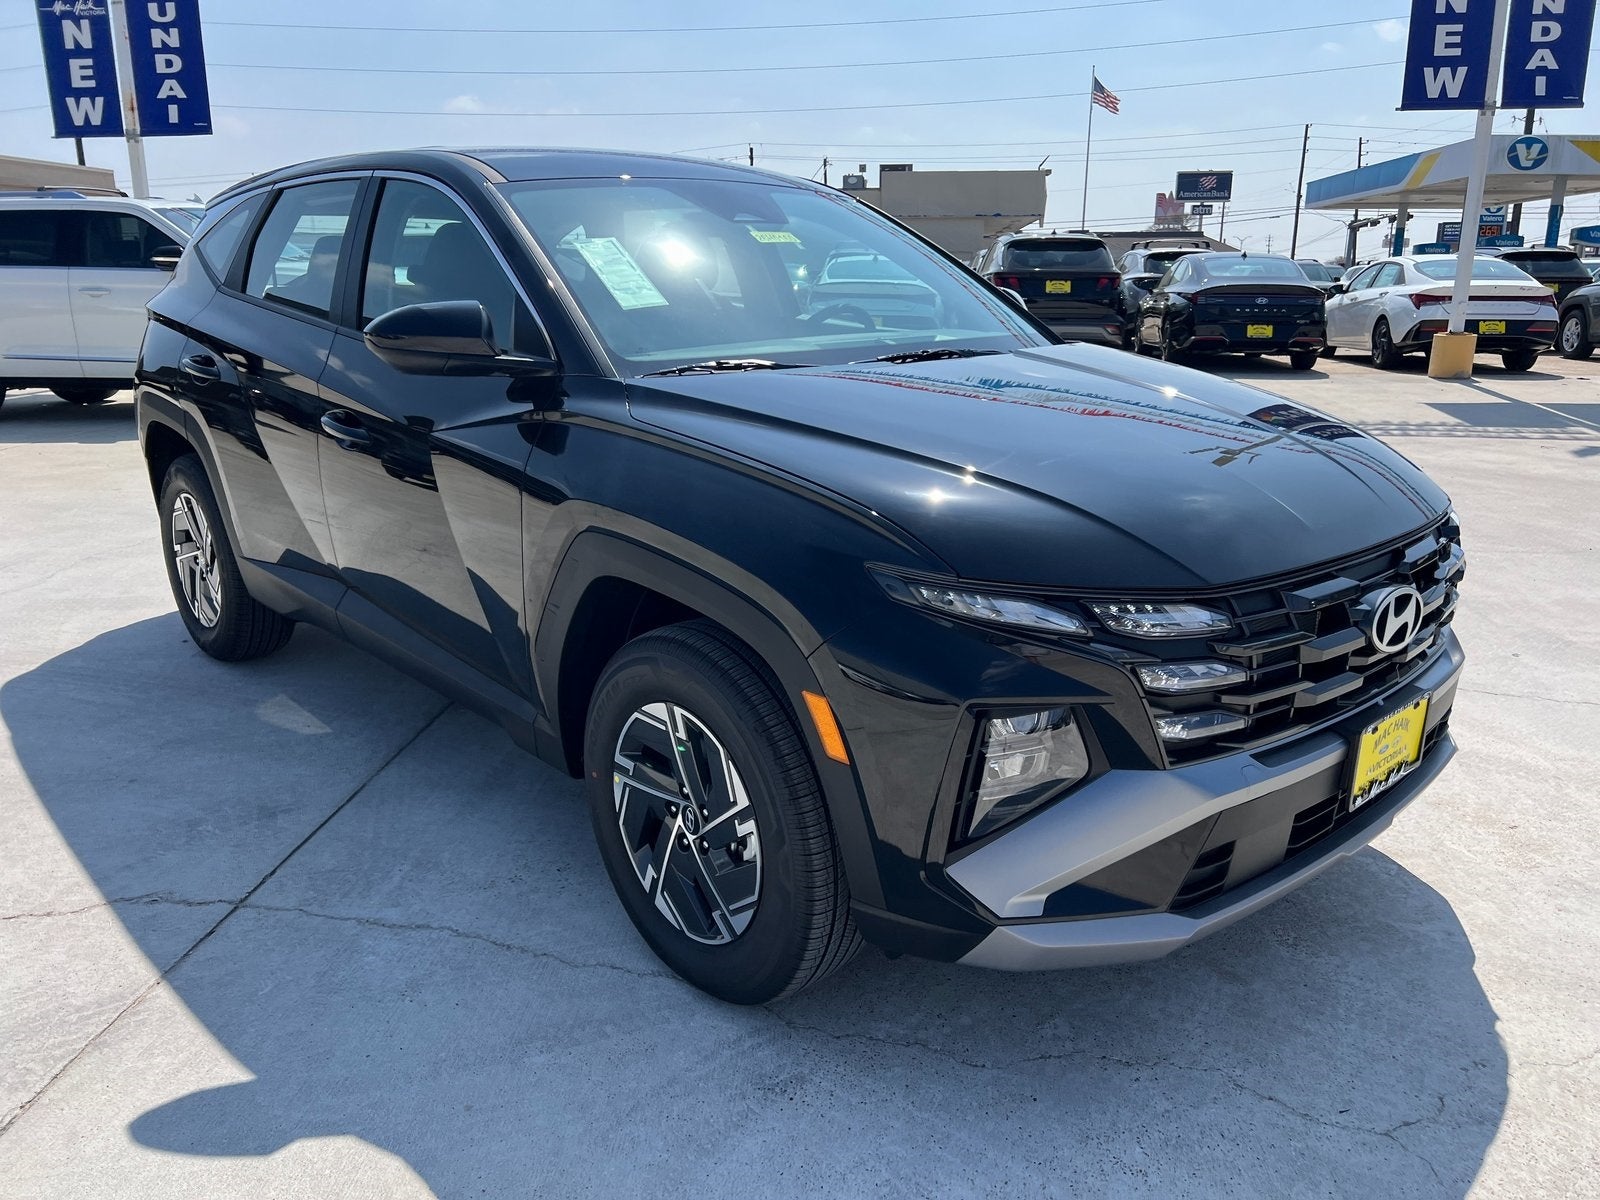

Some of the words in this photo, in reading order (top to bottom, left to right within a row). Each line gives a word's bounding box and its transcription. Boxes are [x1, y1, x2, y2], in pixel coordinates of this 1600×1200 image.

[52, 0, 73, 16] Mac
[61, 19, 104, 126] NEW
[147, 2, 187, 124] UNDAI
